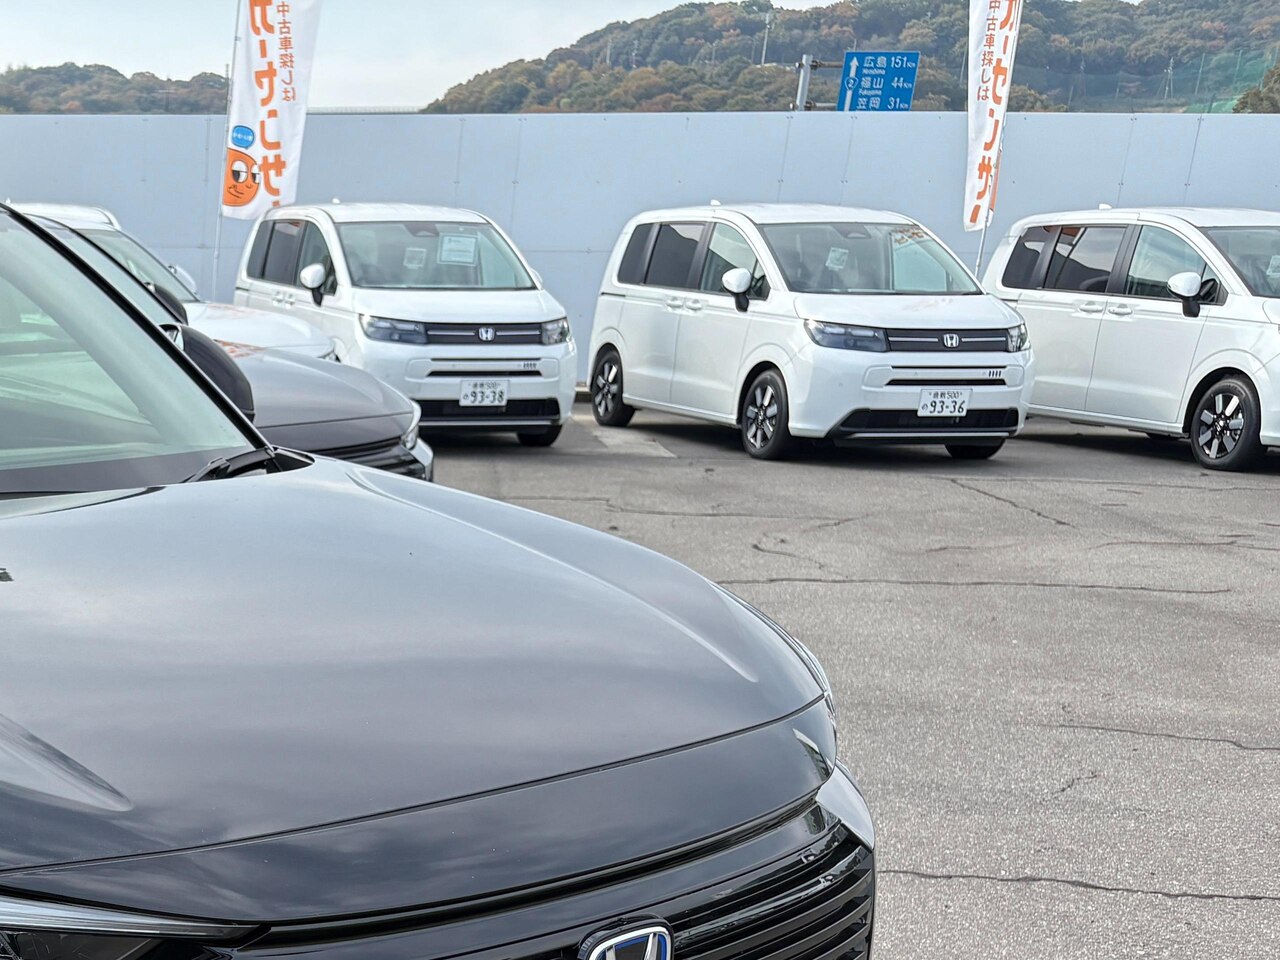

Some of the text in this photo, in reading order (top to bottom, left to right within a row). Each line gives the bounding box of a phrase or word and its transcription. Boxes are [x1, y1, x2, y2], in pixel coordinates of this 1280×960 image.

[977, 0, 1000, 101] 中古車探しは
[863, 56, 887, 68] 広島
[861, 76, 884, 88] 福山
[470, 390, 505, 404] 93-38
[929, 399, 966, 414] 93-36
